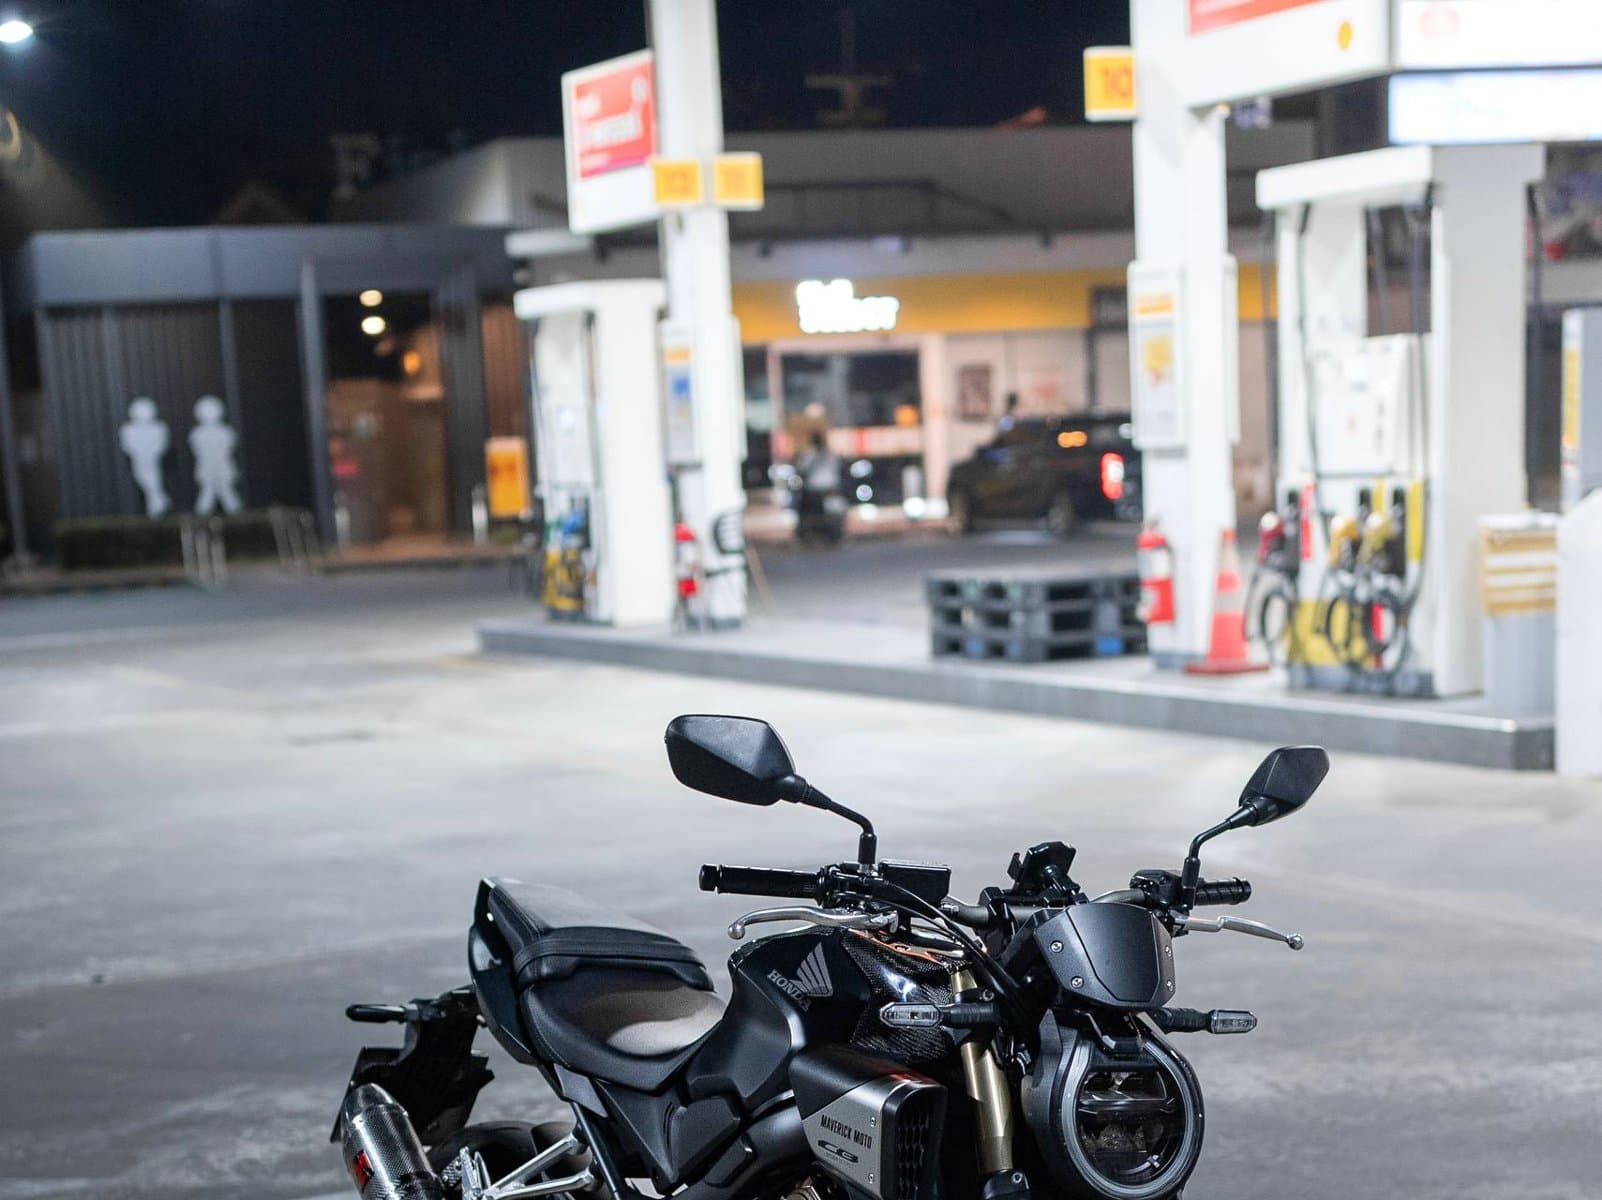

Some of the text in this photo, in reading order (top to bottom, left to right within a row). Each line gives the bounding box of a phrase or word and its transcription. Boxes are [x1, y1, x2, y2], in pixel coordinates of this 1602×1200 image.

[767, 968, 812, 1012] HONDA
[820, 1114, 873, 1150] MAVERICK MOTO
